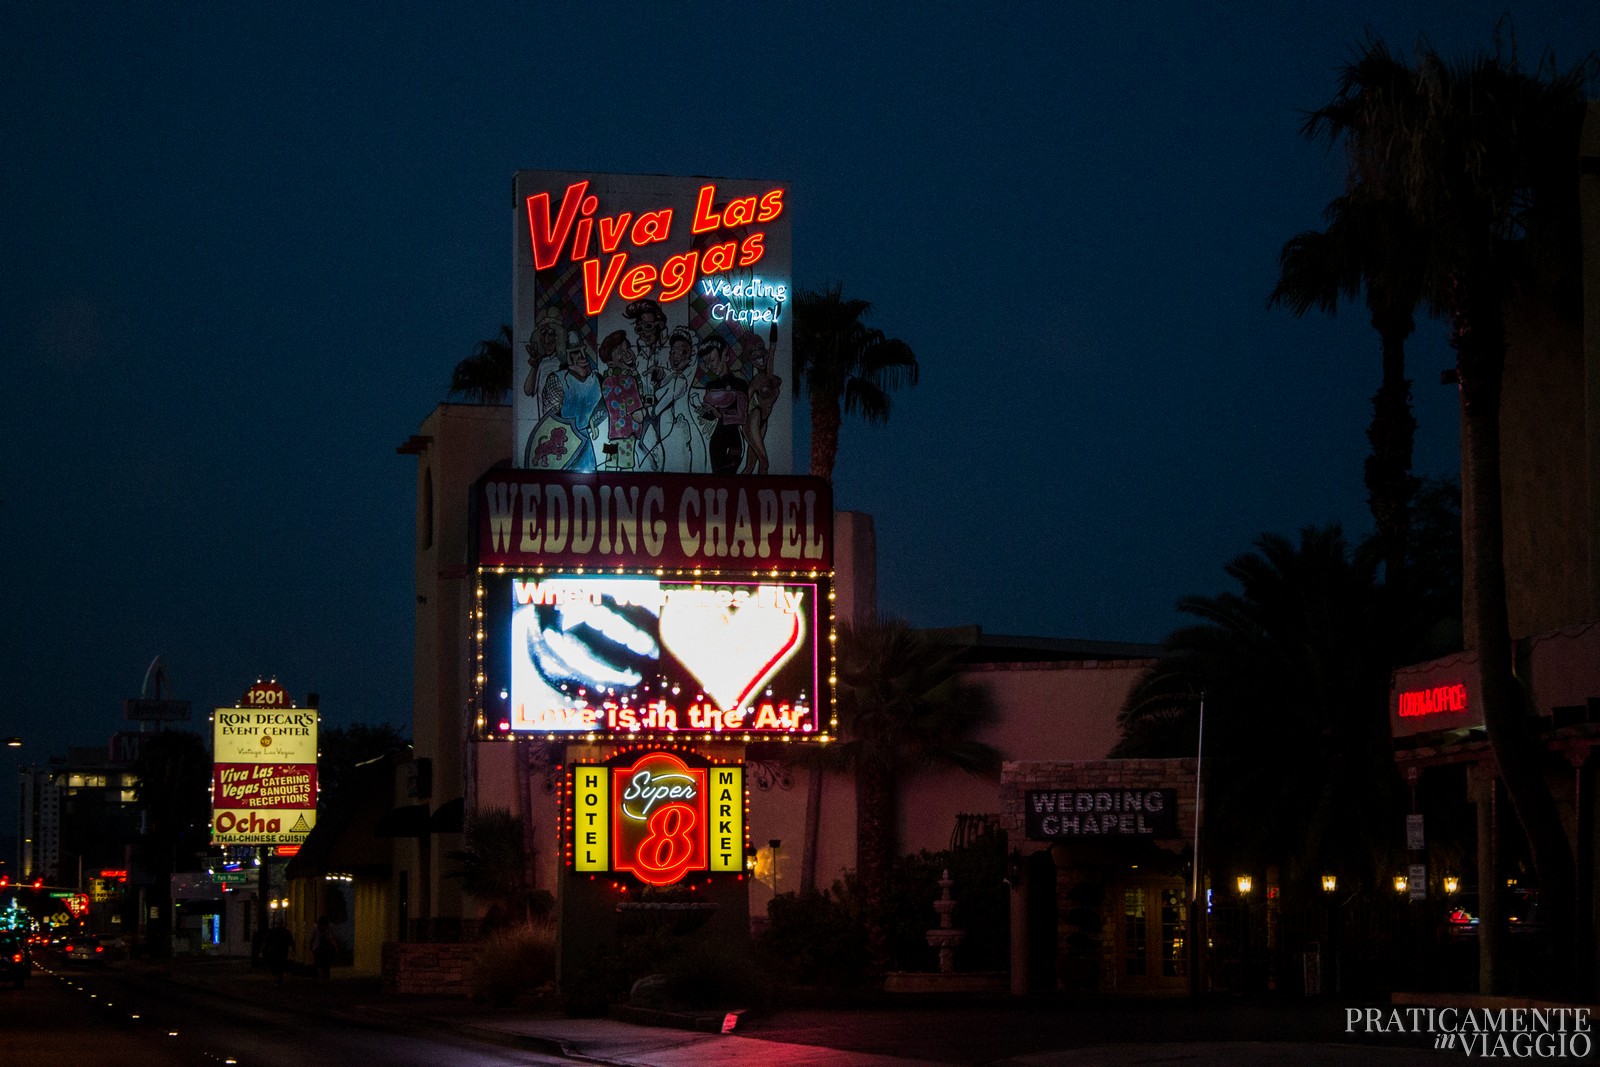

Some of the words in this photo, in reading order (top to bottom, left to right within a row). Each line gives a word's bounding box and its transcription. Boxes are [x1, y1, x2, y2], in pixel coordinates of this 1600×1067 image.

[526, 180, 674, 272] Viva
[692, 184, 785, 235] Las
[582, 232, 765, 316] Vegas
[702, 279, 786, 301] Wedding
[712, 302, 778, 326] Chapel
[485, 481, 667, 556] WEDDING
[678, 486, 824, 560] CHAPEL
[248, 690, 284, 704] 1201
[220, 713, 251, 726] RON
[254, 713, 314, 727] DECAR'S
[516, 703, 597, 726] Love
[607, 703, 637, 728] is
[649, 703, 677, 728] in
[688, 704, 744, 728] the
[756, 704, 804, 728] Air
[222, 727, 260, 735] EVENT
[263, 727, 310, 736] CENTER
[237, 747, 262, 758] Vintage
[276, 747, 295, 758] Vegas
[220, 767, 249, 784] Viva
[252, 765, 274, 779] Las
[262, 774, 310, 787] CATERING
[222, 782, 260, 800] Vegas
[249, 793, 309, 807] RECEPTIONS
[260, 784, 311, 796] BANQUETS
[624, 771, 697, 815] Super
[1031, 790, 1164, 813] WEDDING
[216, 811, 281, 833] Ocha
[585, 775, 598, 863] HOTEL
[719, 772, 733, 866] MARKET
[1042, 813, 1153, 835] CHAPEL
[215, 834, 276, 843] THAI-CHINESE
[636, 803, 696, 871] 8
